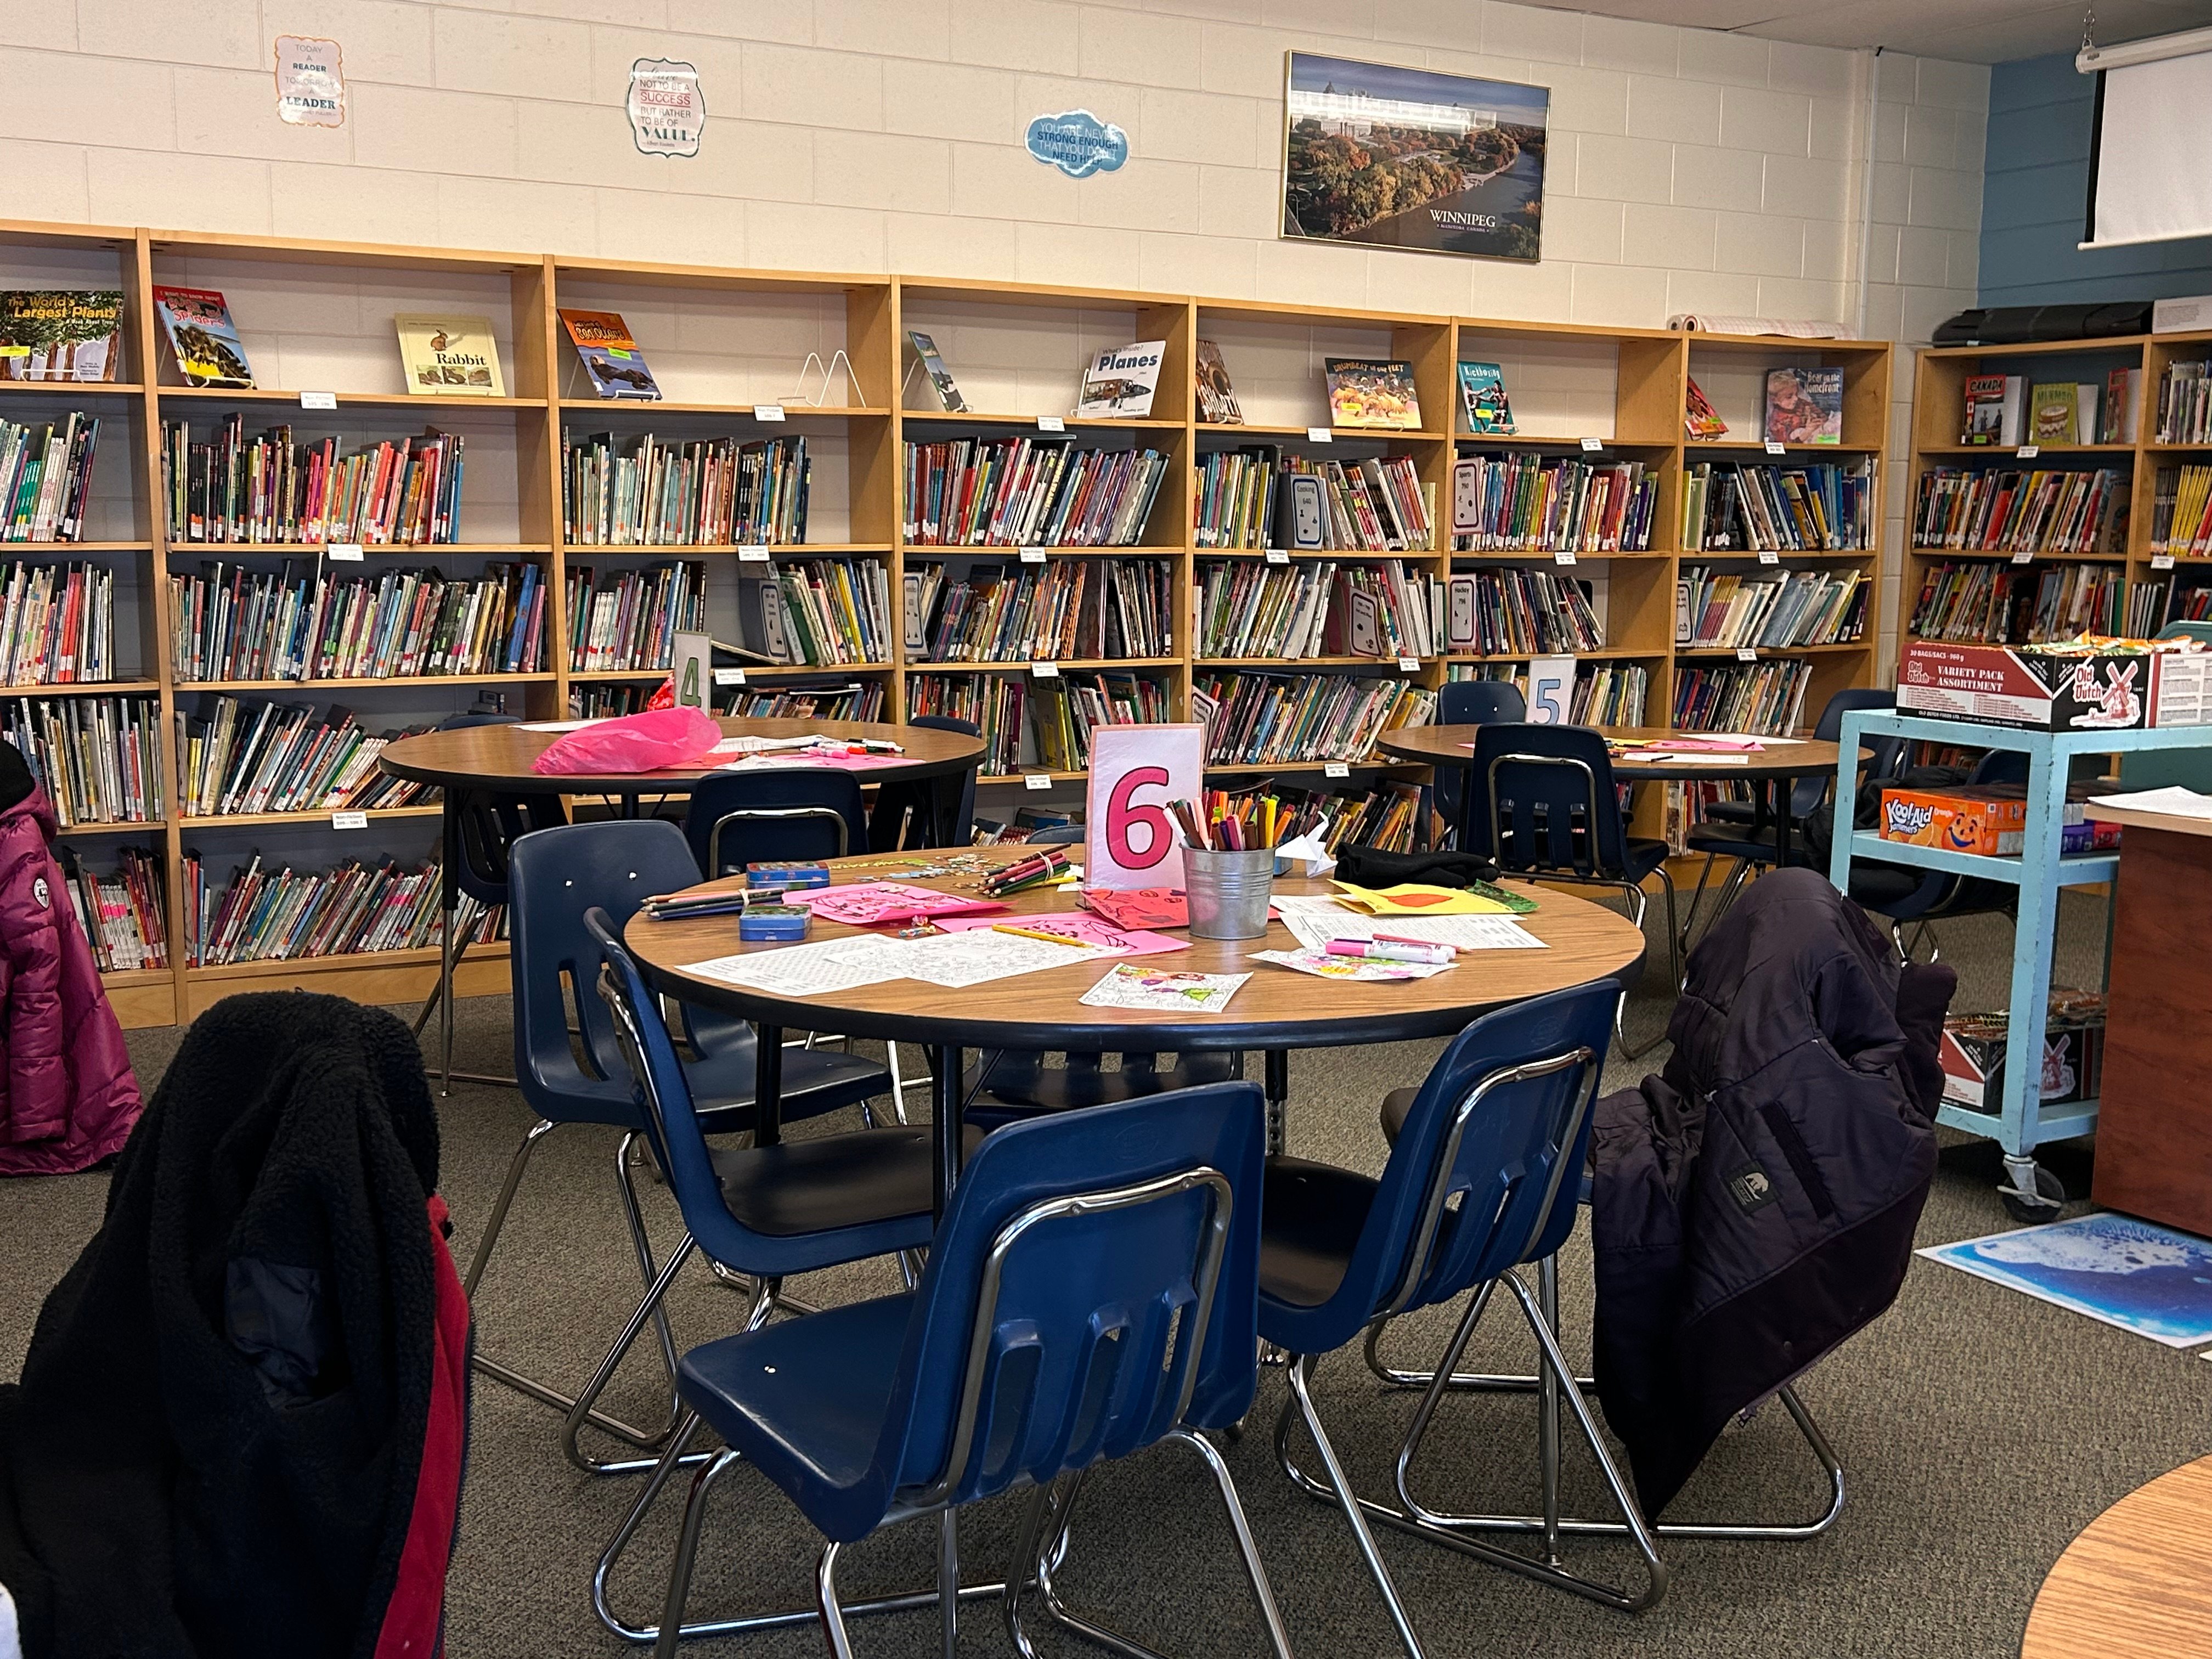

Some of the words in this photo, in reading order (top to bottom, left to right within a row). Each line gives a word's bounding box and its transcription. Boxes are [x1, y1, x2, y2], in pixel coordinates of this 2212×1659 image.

[295, 44, 323, 53] TODAY
[293, 63, 326, 72] READER
[640, 80, 657, 88] NOT
[286, 97, 336, 109] LEADER
[640, 92, 690, 105] SUCCESS
[641, 106, 657, 115] BUT
[659, 108, 691, 118] RATHER
[1040, 122, 1060, 133] YOU
[1037, 132, 1076, 145] STRONG
[1079, 137, 1118, 150] ENOUGH
[1040, 141, 1062, 151] THAT
[1065, 143, 1085, 155] YOU
[1053, 151, 1077, 162] NEED
[1430, 209, 1496, 227] WINNIPEG
[8, 298, 25, 307] The
[30, 296, 75, 307] World's
[14, 307, 67, 319] Largest
[436, 353, 487, 365] Rabbit
[1098, 354, 1159, 371] Planes
[1970, 379, 2002, 392] CANADA
[1297, 485, 1315, 494] Cooking
[1917, 650, 1946, 659] BAGS/SACS
[1909, 662, 1921, 672] Old
[1938, 665, 1977, 679] VARIETY
[1979, 669, 2005, 681] PACK
[2076, 667, 2093, 682] Old
[680, 657, 702, 708] 4
[1936, 676, 2003, 692] ASSORTIMENT
[2075, 684, 2102, 700] Dutch
[1536, 679, 1561, 725] 5
[1105, 766, 1173, 870] 6
[1934, 808, 1954, 818] Orange
